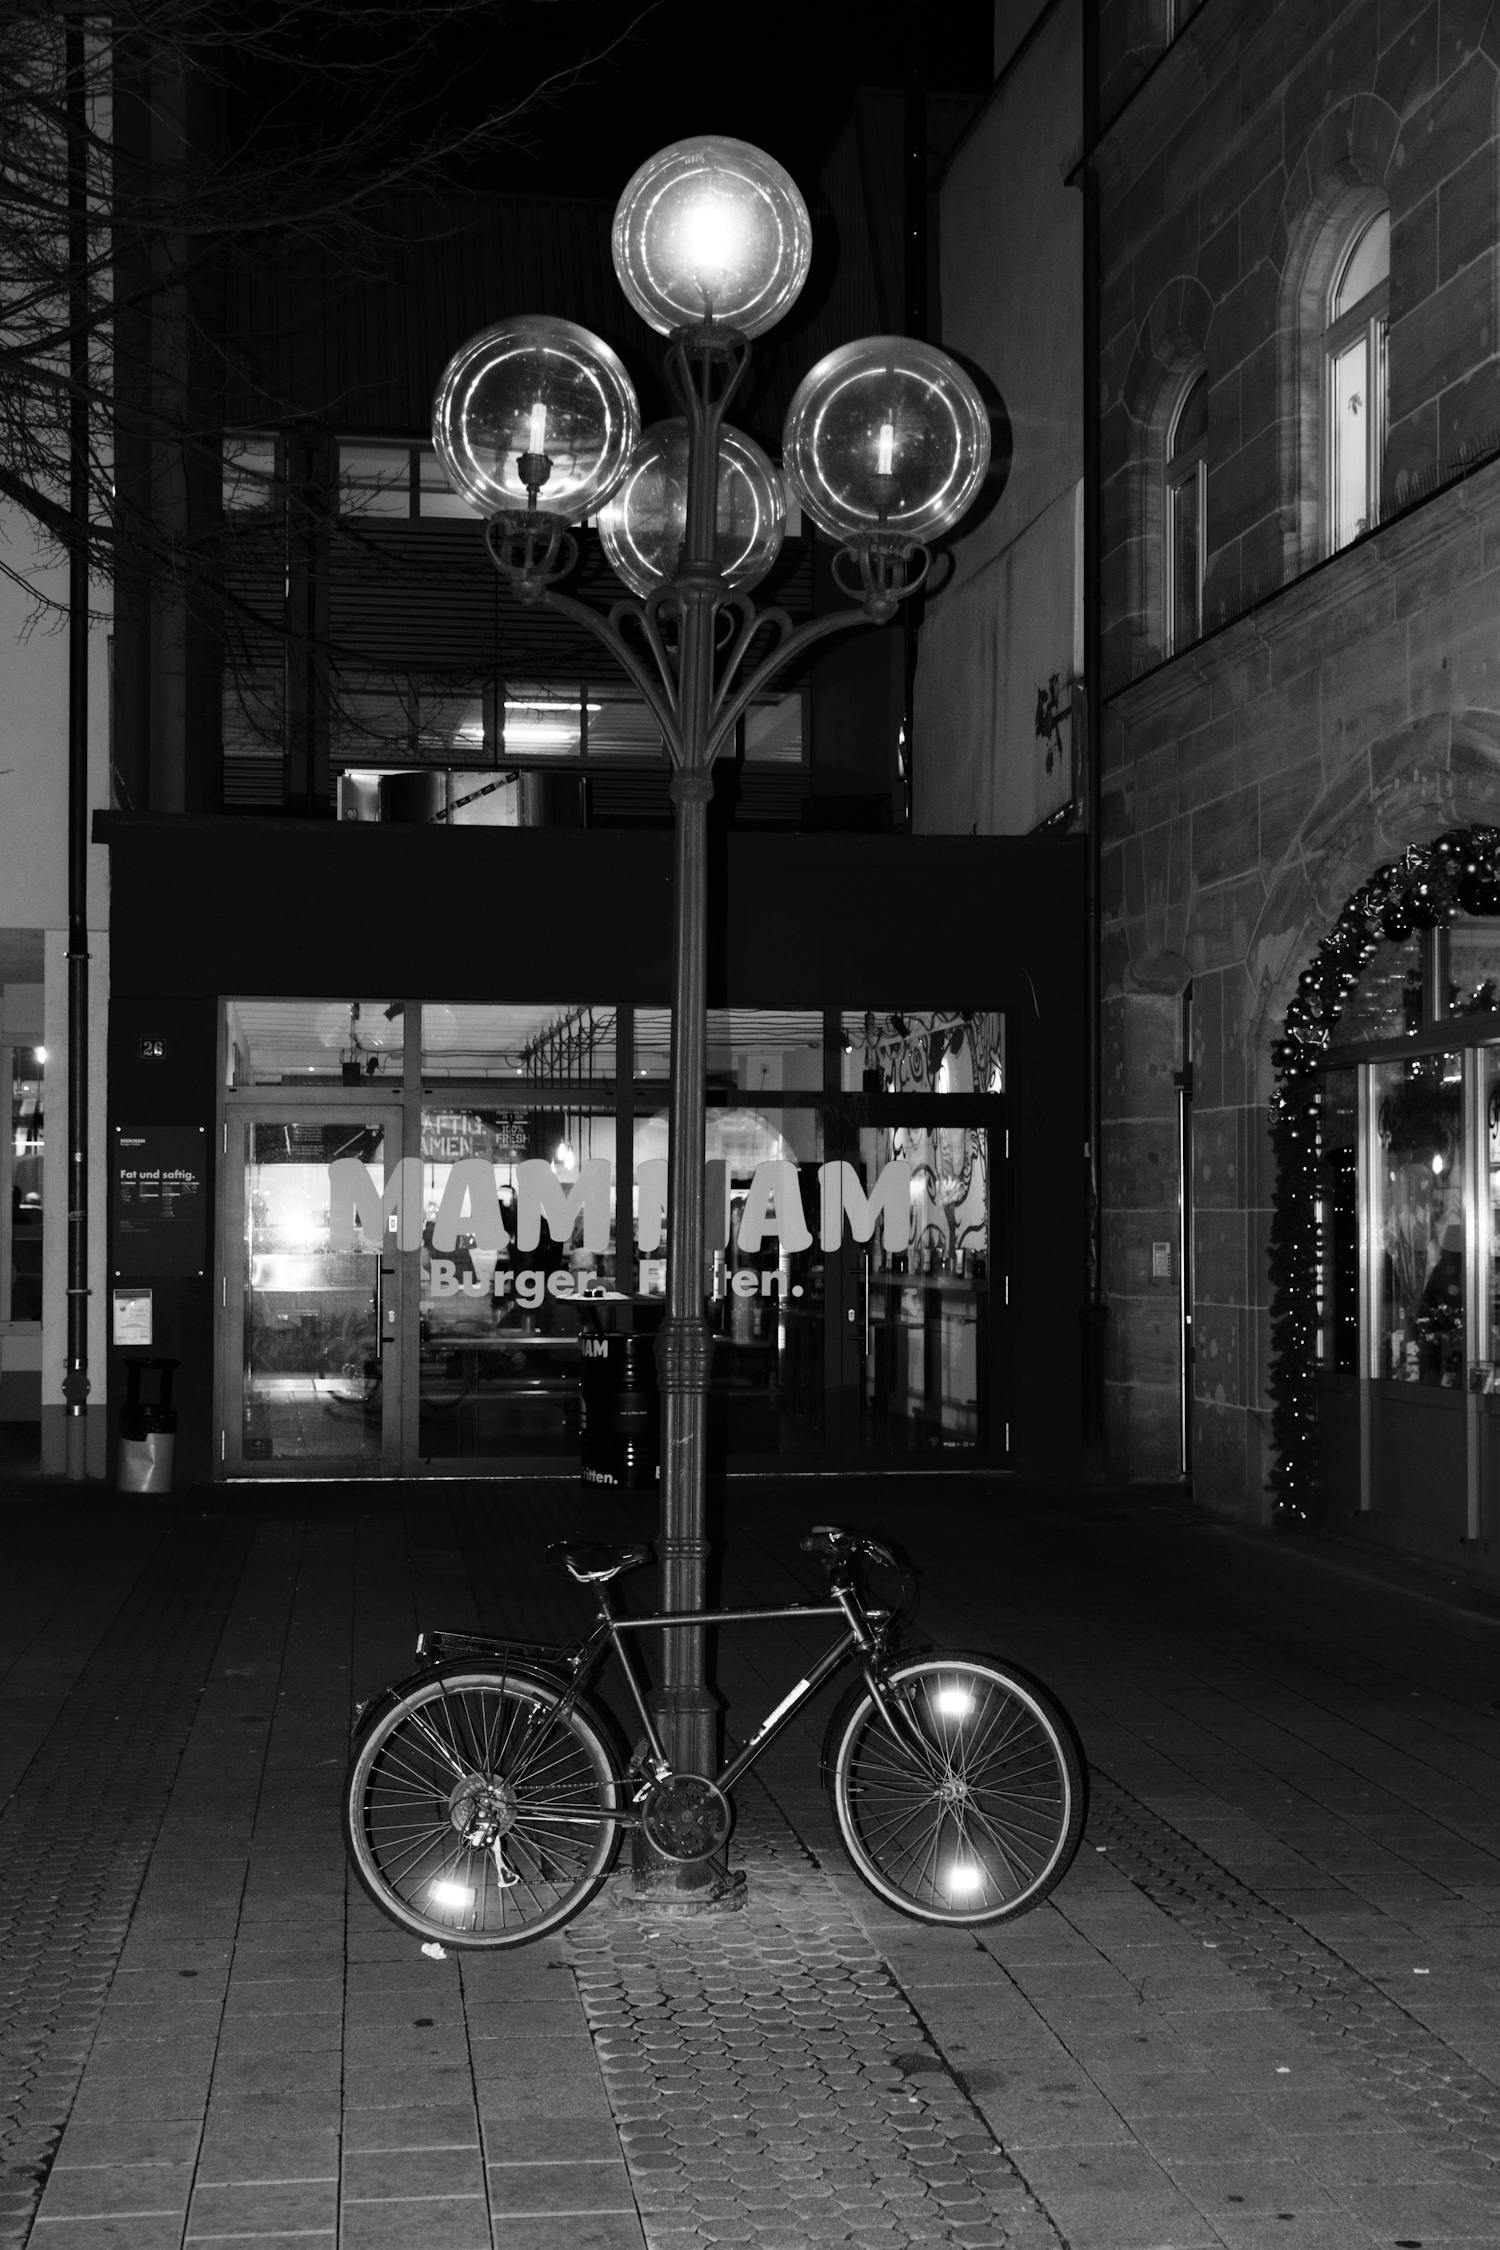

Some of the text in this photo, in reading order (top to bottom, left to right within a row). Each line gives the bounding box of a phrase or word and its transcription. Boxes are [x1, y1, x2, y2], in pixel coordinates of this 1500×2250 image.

[144, 1041, 163, 1056] 26
[496, 1133, 530, 1144] FRESH
[120, 1169, 196, 1181] Fat und saftig.
[328, 1158, 611, 1252] MAM
[430, 1259, 607, 1308] Burger.
[582, 1339, 608, 1358] AM
